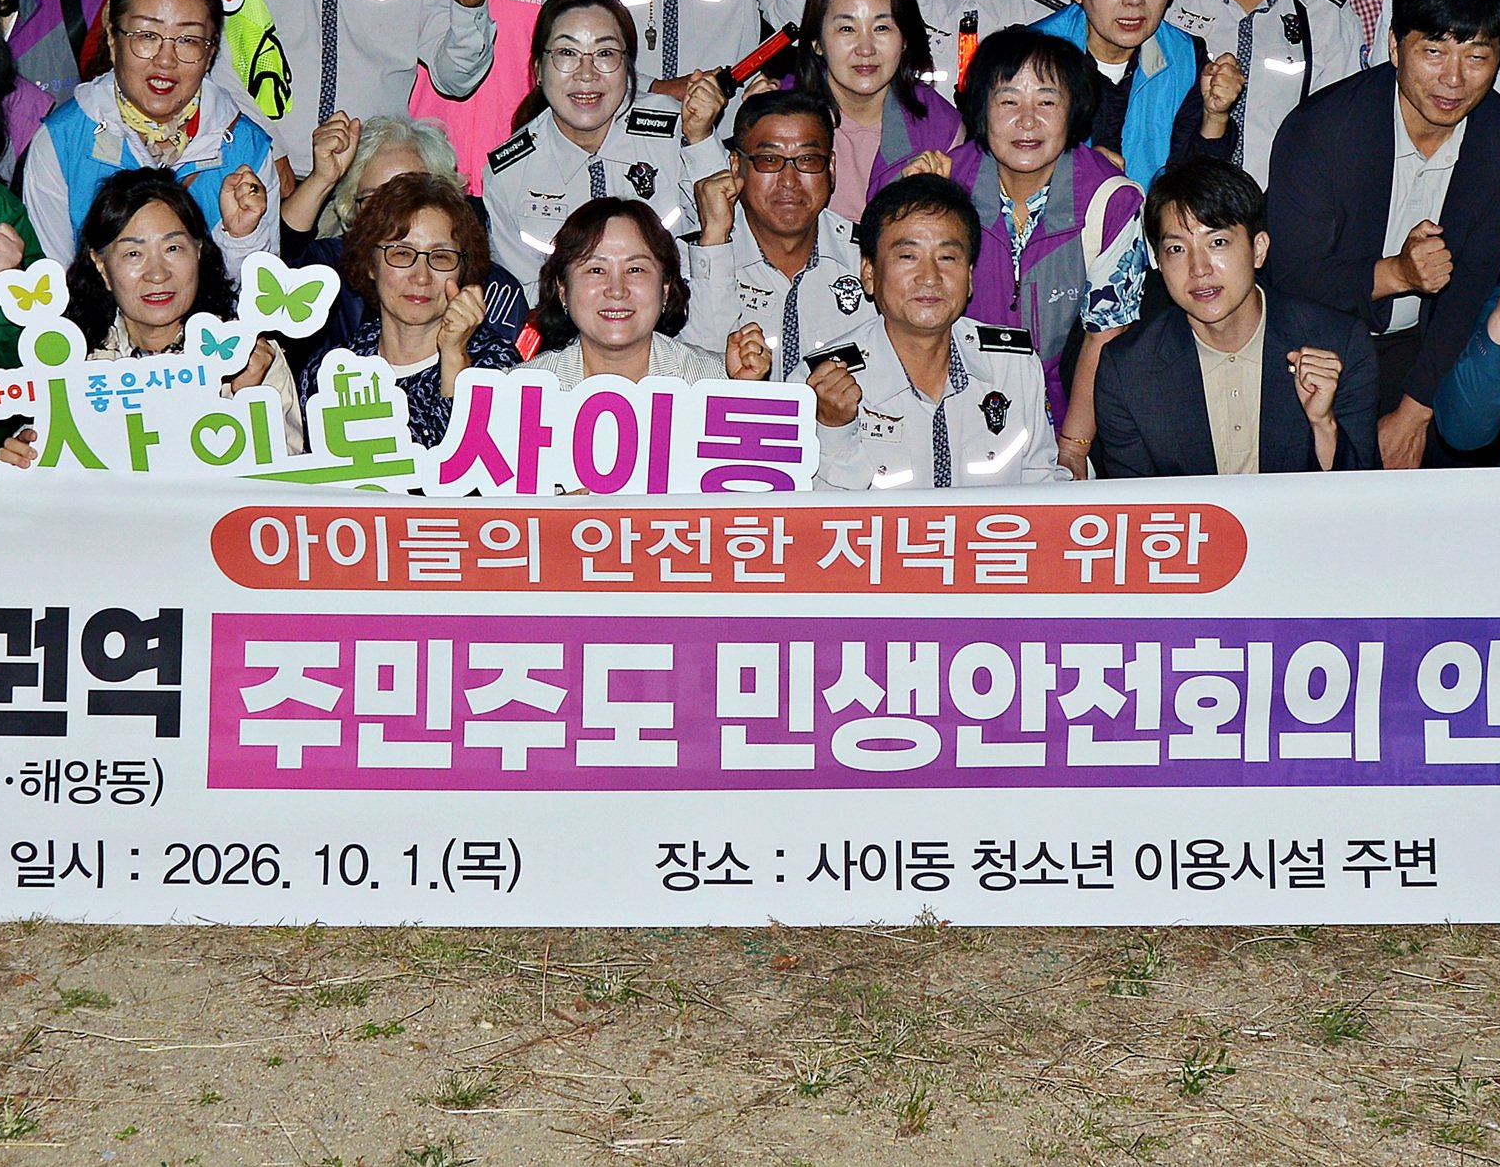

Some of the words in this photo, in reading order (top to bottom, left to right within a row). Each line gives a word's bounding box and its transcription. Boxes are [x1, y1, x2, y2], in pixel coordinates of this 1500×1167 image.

[85, 364, 206, 413] 좋은사이
[439, 384, 803, 495] 사이동
[248, 515, 542, 585] 아이들의
[571, 516, 793, 584] 안전한
[816, 515, 1038, 585] 저녁을
[1063, 513, 1209, 585] 위한
[239, 638, 679, 772] 주민주도
[715, 637, 1385, 773] 민생안전회의
[10, 839, 104, 889] 일시
[163, 843, 291, 889] 2026.
[314, 843, 379, 890] 10.
[403, 837, 521, 893] 1.(목)
[655, 840, 753, 892] 장소
[807, 840, 955, 892] 사이동
[971, 839, 1115, 892] 청소년
[1135, 838, 1326, 891] 이용시설
[1342, 837, 1438, 889] 주변
